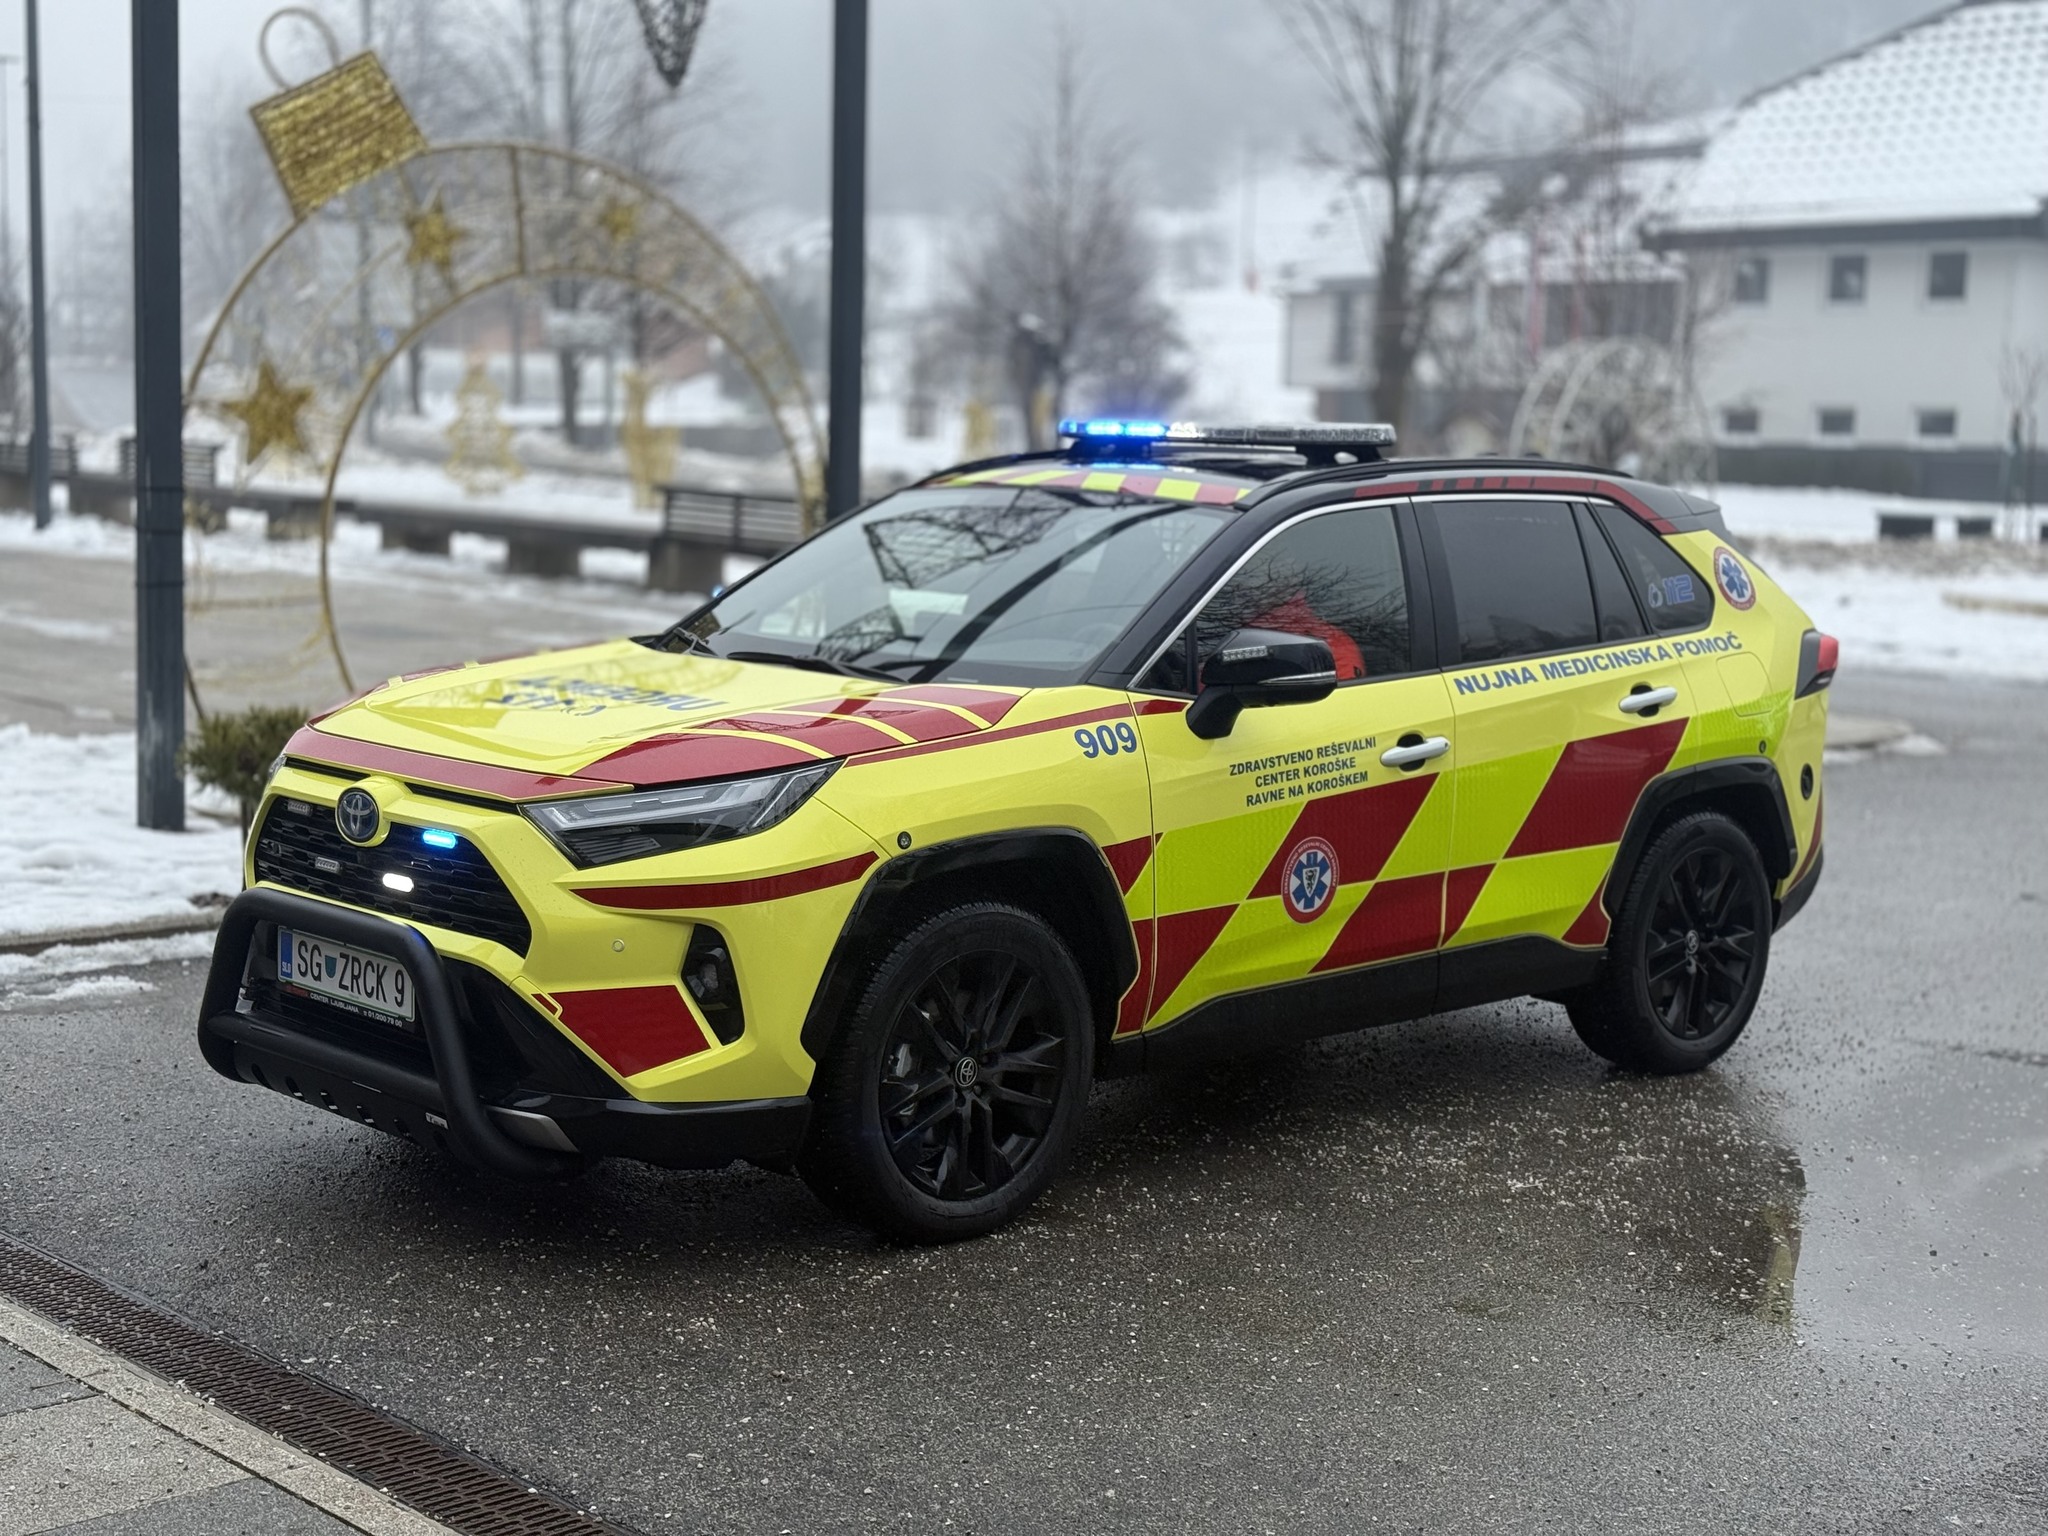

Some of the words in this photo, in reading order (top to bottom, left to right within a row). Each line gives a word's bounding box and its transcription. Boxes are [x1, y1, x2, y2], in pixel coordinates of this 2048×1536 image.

[1454, 666, 1538, 695] NUJNA
[1540, 645, 1673, 680] MEDICINSKA
[1672, 631, 1743, 658] POMOČ
[1074, 722, 1137, 758] 909
[1229, 749, 1313, 776] ZDRAVSTVENO
[1317, 736, 1376, 758] REŠEVALNI
[1246, 788, 1285, 807] RAVNE
[1288, 784, 1304, 798] NA
[1307, 771, 1368, 794] KOROŠKEM
[1255, 768, 1300, 788] CENTER
[1303, 757, 1356, 778] KOROŠKE
[297, 940, 322, 982] SG
[339, 952, 387, 1003] ZRCK
[395, 969, 405, 1008] 9
